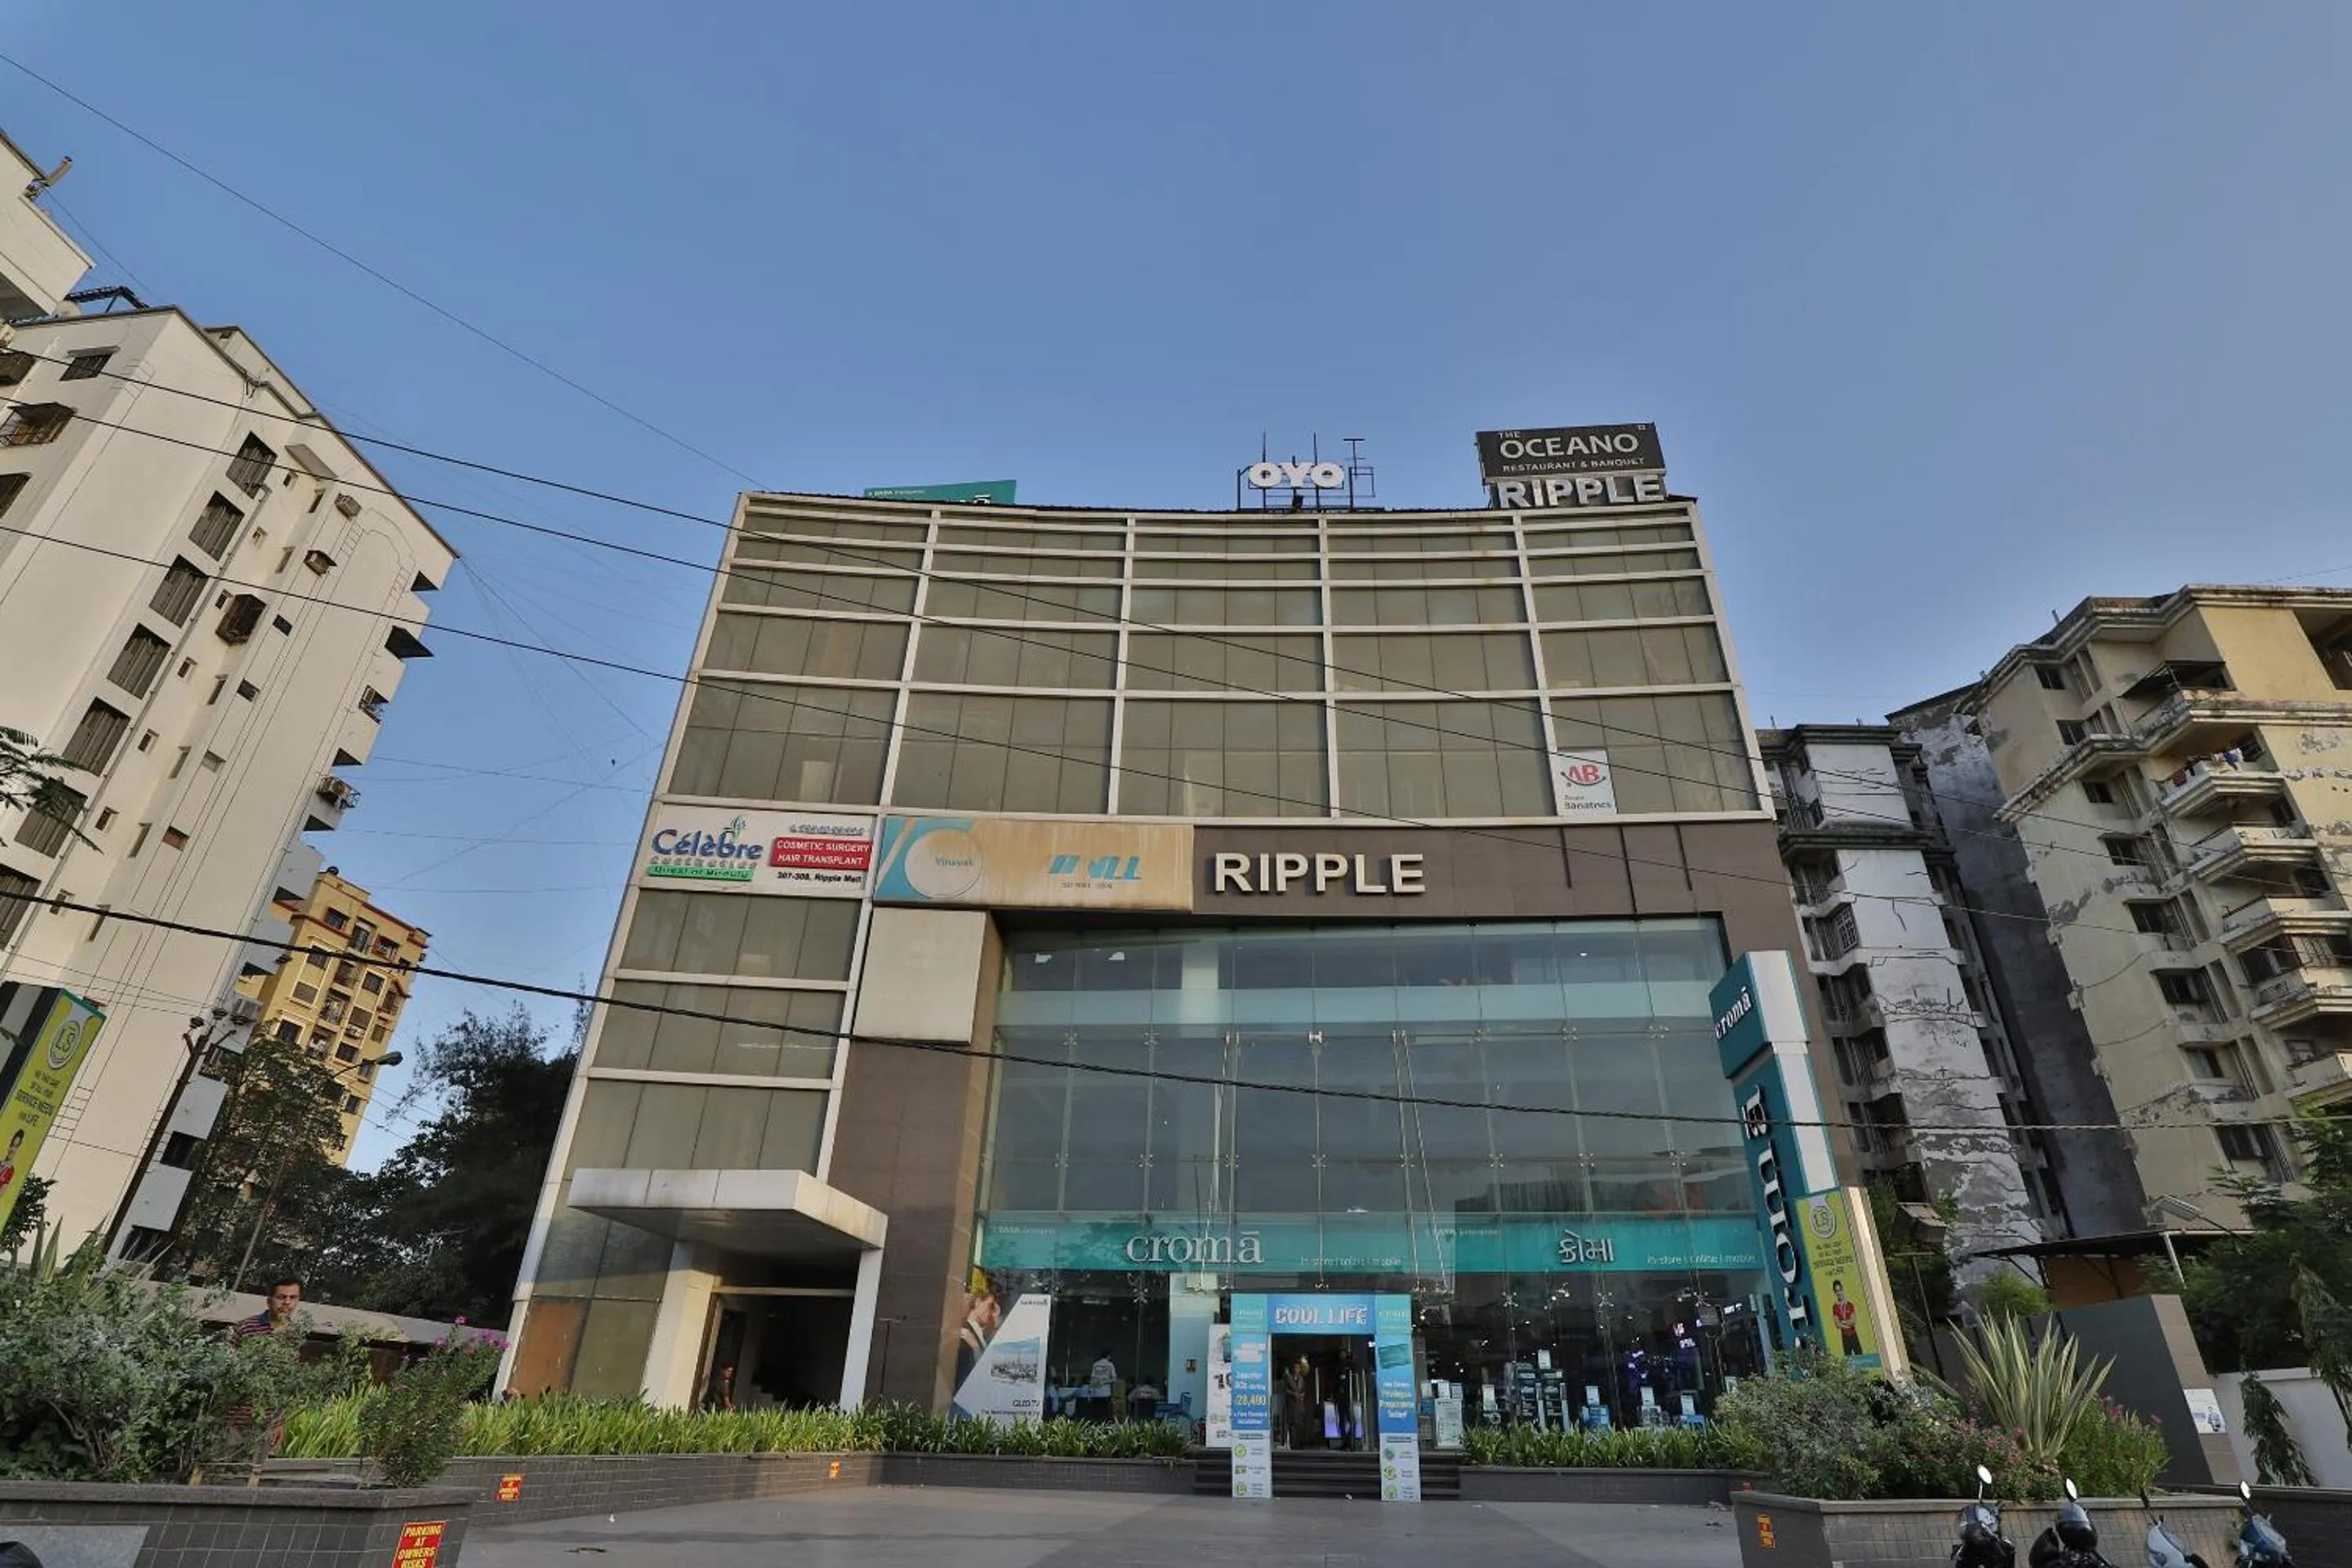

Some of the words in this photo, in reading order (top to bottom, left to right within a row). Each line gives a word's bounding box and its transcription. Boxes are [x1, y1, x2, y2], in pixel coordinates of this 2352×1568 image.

[1498, 430, 1520, 439] THE
[1499, 433, 1639, 459] OCEANO
[1503, 462, 1575, 472] RESTAURANT
[1580, 460, 1588, 468] &
[1591, 457, 1645, 468] BANQUET
[1249, 462, 1344, 488] OYO
[1497, 474, 1664, 509] RIPPLE
[777, 840, 823, 851] COSMETIC
[826, 842, 869, 852] SURGERY
[777, 853, 800, 862] HAIR
[803, 854, 863, 865] TRANSPLANT
[815, 873, 841, 883] Ripple
[1214, 853, 1426, 893] RIPPLE
[1327, 1306, 1368, 1325] LIFE
[404, 1525, 443, 1537] PARKING
[414, 1537, 426, 1547] AT
[398, 1547, 437, 1561] OWNERS
